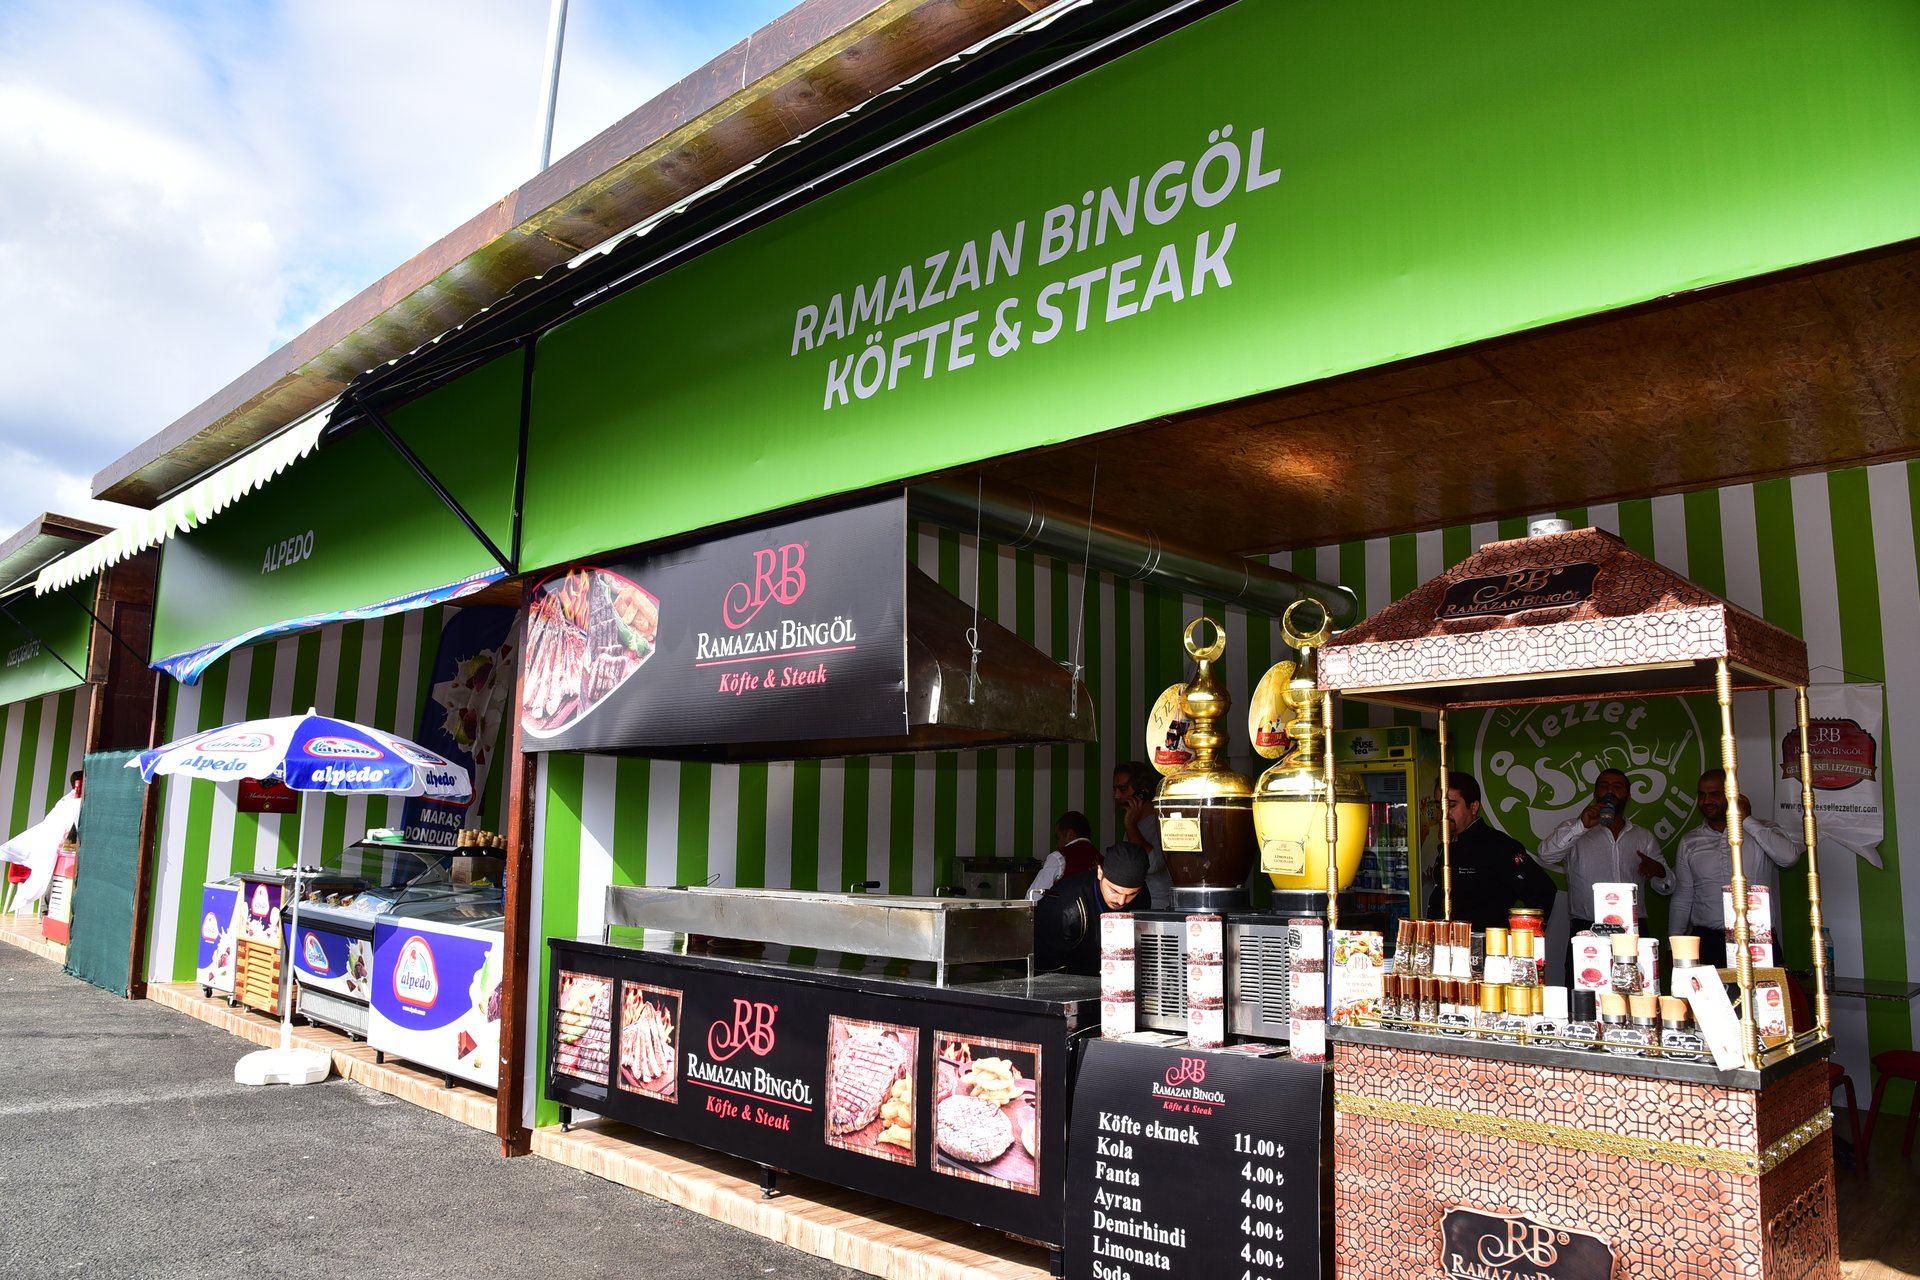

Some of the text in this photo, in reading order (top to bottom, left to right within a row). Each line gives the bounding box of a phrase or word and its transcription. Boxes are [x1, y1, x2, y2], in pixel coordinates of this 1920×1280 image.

[791, 220, 1026, 356] RAMAZAN
[823, 222, 1237, 411] KÖFTE & STEAK
[261, 530, 314, 575] ALPEDO
[723, 543, 807, 630] RB
[718, 663, 828, 696] Köfte & Steak
[1524, 701, 1648, 749] lezzet
[179, 756, 248, 771] alpedo
[311, 765, 384, 785] alpedo
[426, 770, 455, 788] alpedo
[420, 808, 462, 831] MARAŞ
[401, 972, 431, 990] alpedo
[708, 998, 775, 1062] RB
[705, 1095, 791, 1131] Köfte & Steak
[1163, 1101, 1212, 1115] Köfte & Steak
[1098, 1111, 1141, 1136] Köfte
[1145, 1120, 1200, 1146] ekmek
[1096, 1136, 1133, 1160] Kola
[1095, 1160, 1140, 1187] Fanta
[1093, 1186, 1142, 1213] Ayran
[1093, 1210, 1187, 1249] Demirhindi
[1477, 1218, 1558, 1268] RB
[1092, 1235, 1171, 1271] Limonata
